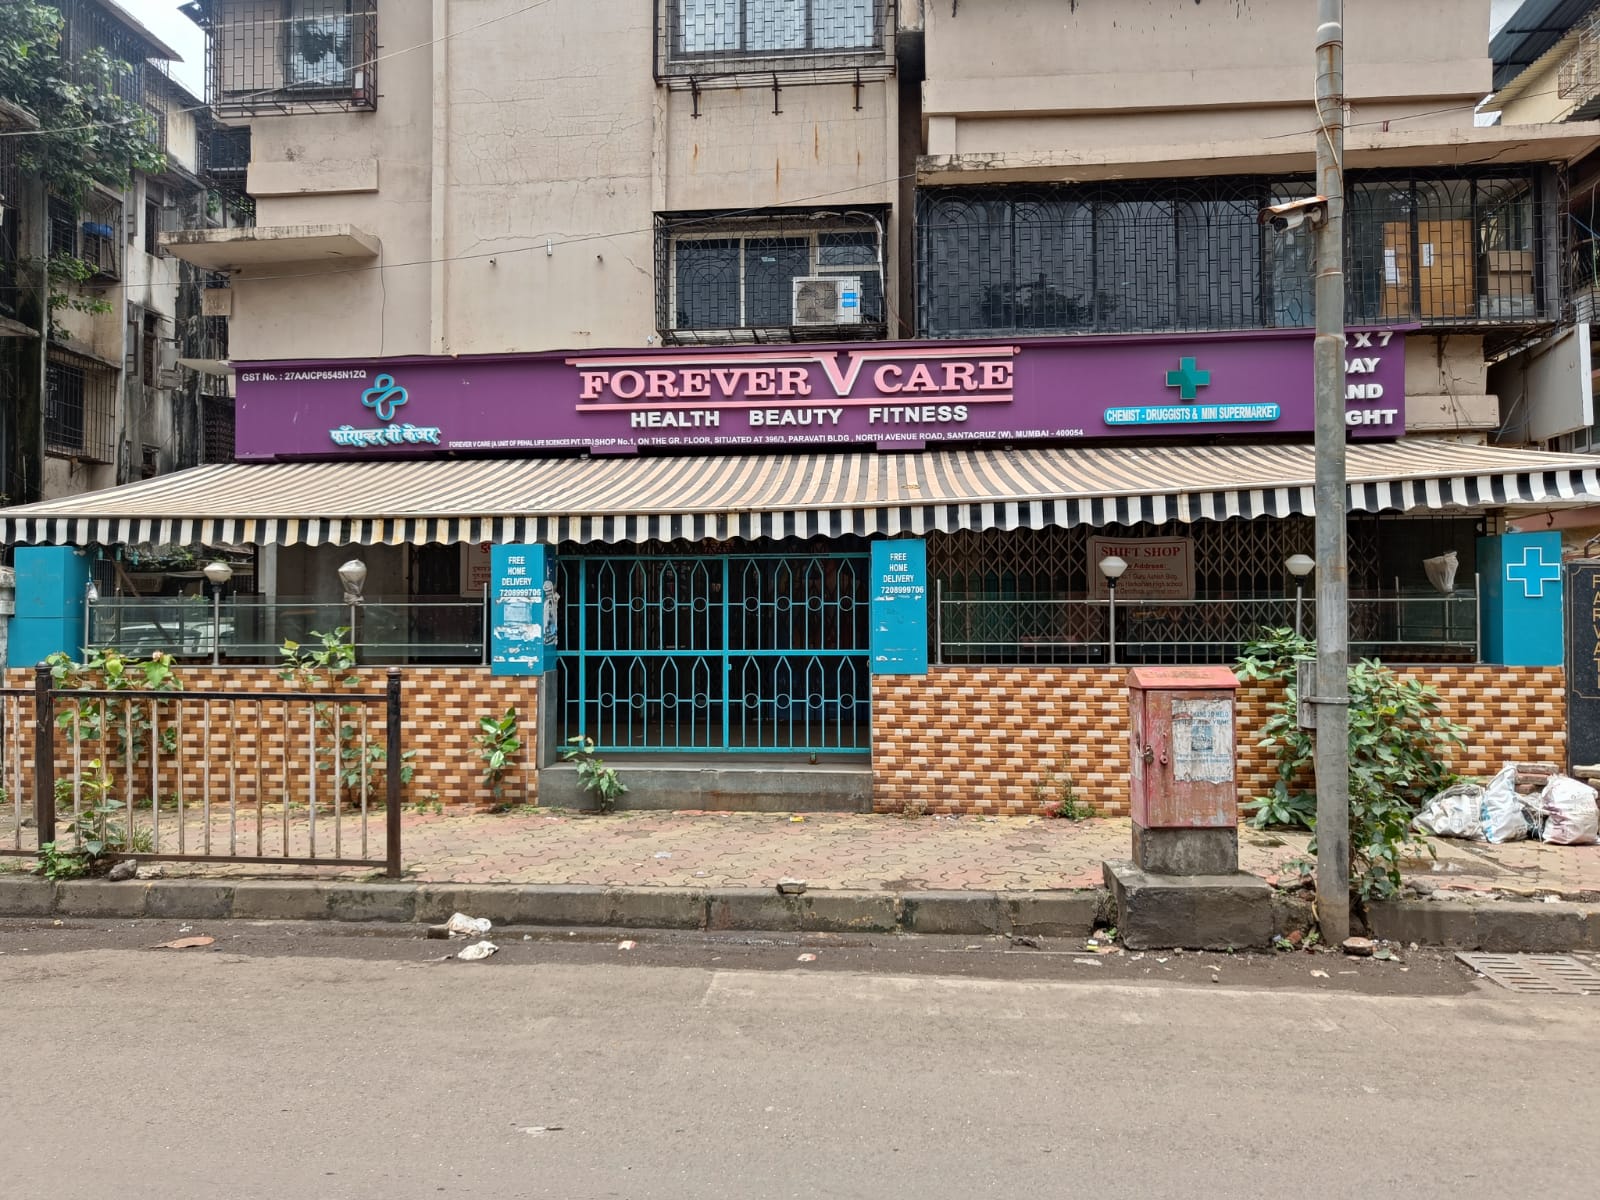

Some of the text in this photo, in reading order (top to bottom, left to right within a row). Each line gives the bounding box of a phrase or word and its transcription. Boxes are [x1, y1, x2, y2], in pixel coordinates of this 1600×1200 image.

[1353, 332, 1373, 348] X
[1377, 331, 1394, 347] 7
[1345, 357, 1381, 374] AY
[241, 373, 260, 382] GST
[262, 372, 278, 381] No.
[579, 350, 1014, 399] FOREVER V CARE
[1345, 383, 1384, 399] ND
[630, 405, 968, 428] HEALTH BEAUTY FITNESS
[1106, 409, 1140, 422] CHEMIST
[1146, 407, 1191, 421] DRUGGISTS
[1191, 407, 1199, 420] &
[1201, 406, 1218, 420] MINI
[1219, 404, 1278, 419] SUPERMARKET
[1345, 409, 1398, 425] GHT
[385, 423, 405, 445] वी
[402, 422, 442, 446] केअर
[448, 440, 473, 448] FOREVER
[477, 440, 491, 448] CARE
[510, 439, 517, 447] OF
[545, 438, 570, 446] SCIENCES
[594, 438, 616, 447] SHOP
[638, 437, 650, 446] ON
[651, 437, 667, 446] THE
[668, 436, 682, 446] GR.
[683, 436, 713, 446] FLOOR,
[714, 435, 752, 445] SITUATED
[752, 435, 763, 444] AT
[788, 434, 826, 444] PARAVATI
[855, 433, 884, 442] NORTH
[884, 432, 918, 442] AVENUE
[919, 431, 945, 441] ROAD,
[946, 430, 997, 441] SANTACRUZ
[1015, 429, 1050, 439] MUMBAI
[1055, 428, 1084, 438] 400054
[890, 553, 907, 561] FREE
[1101, 546, 1181, 557] SHIFT SHOP
[508, 557, 526, 565] FREE
[508, 567, 527, 575] HOME
[890, 564, 908, 572] HOME
[502, 578, 532, 586] DELIVERY
[883, 575, 914, 583] DELIVERY
[881, 586, 925, 594] 7208999706
